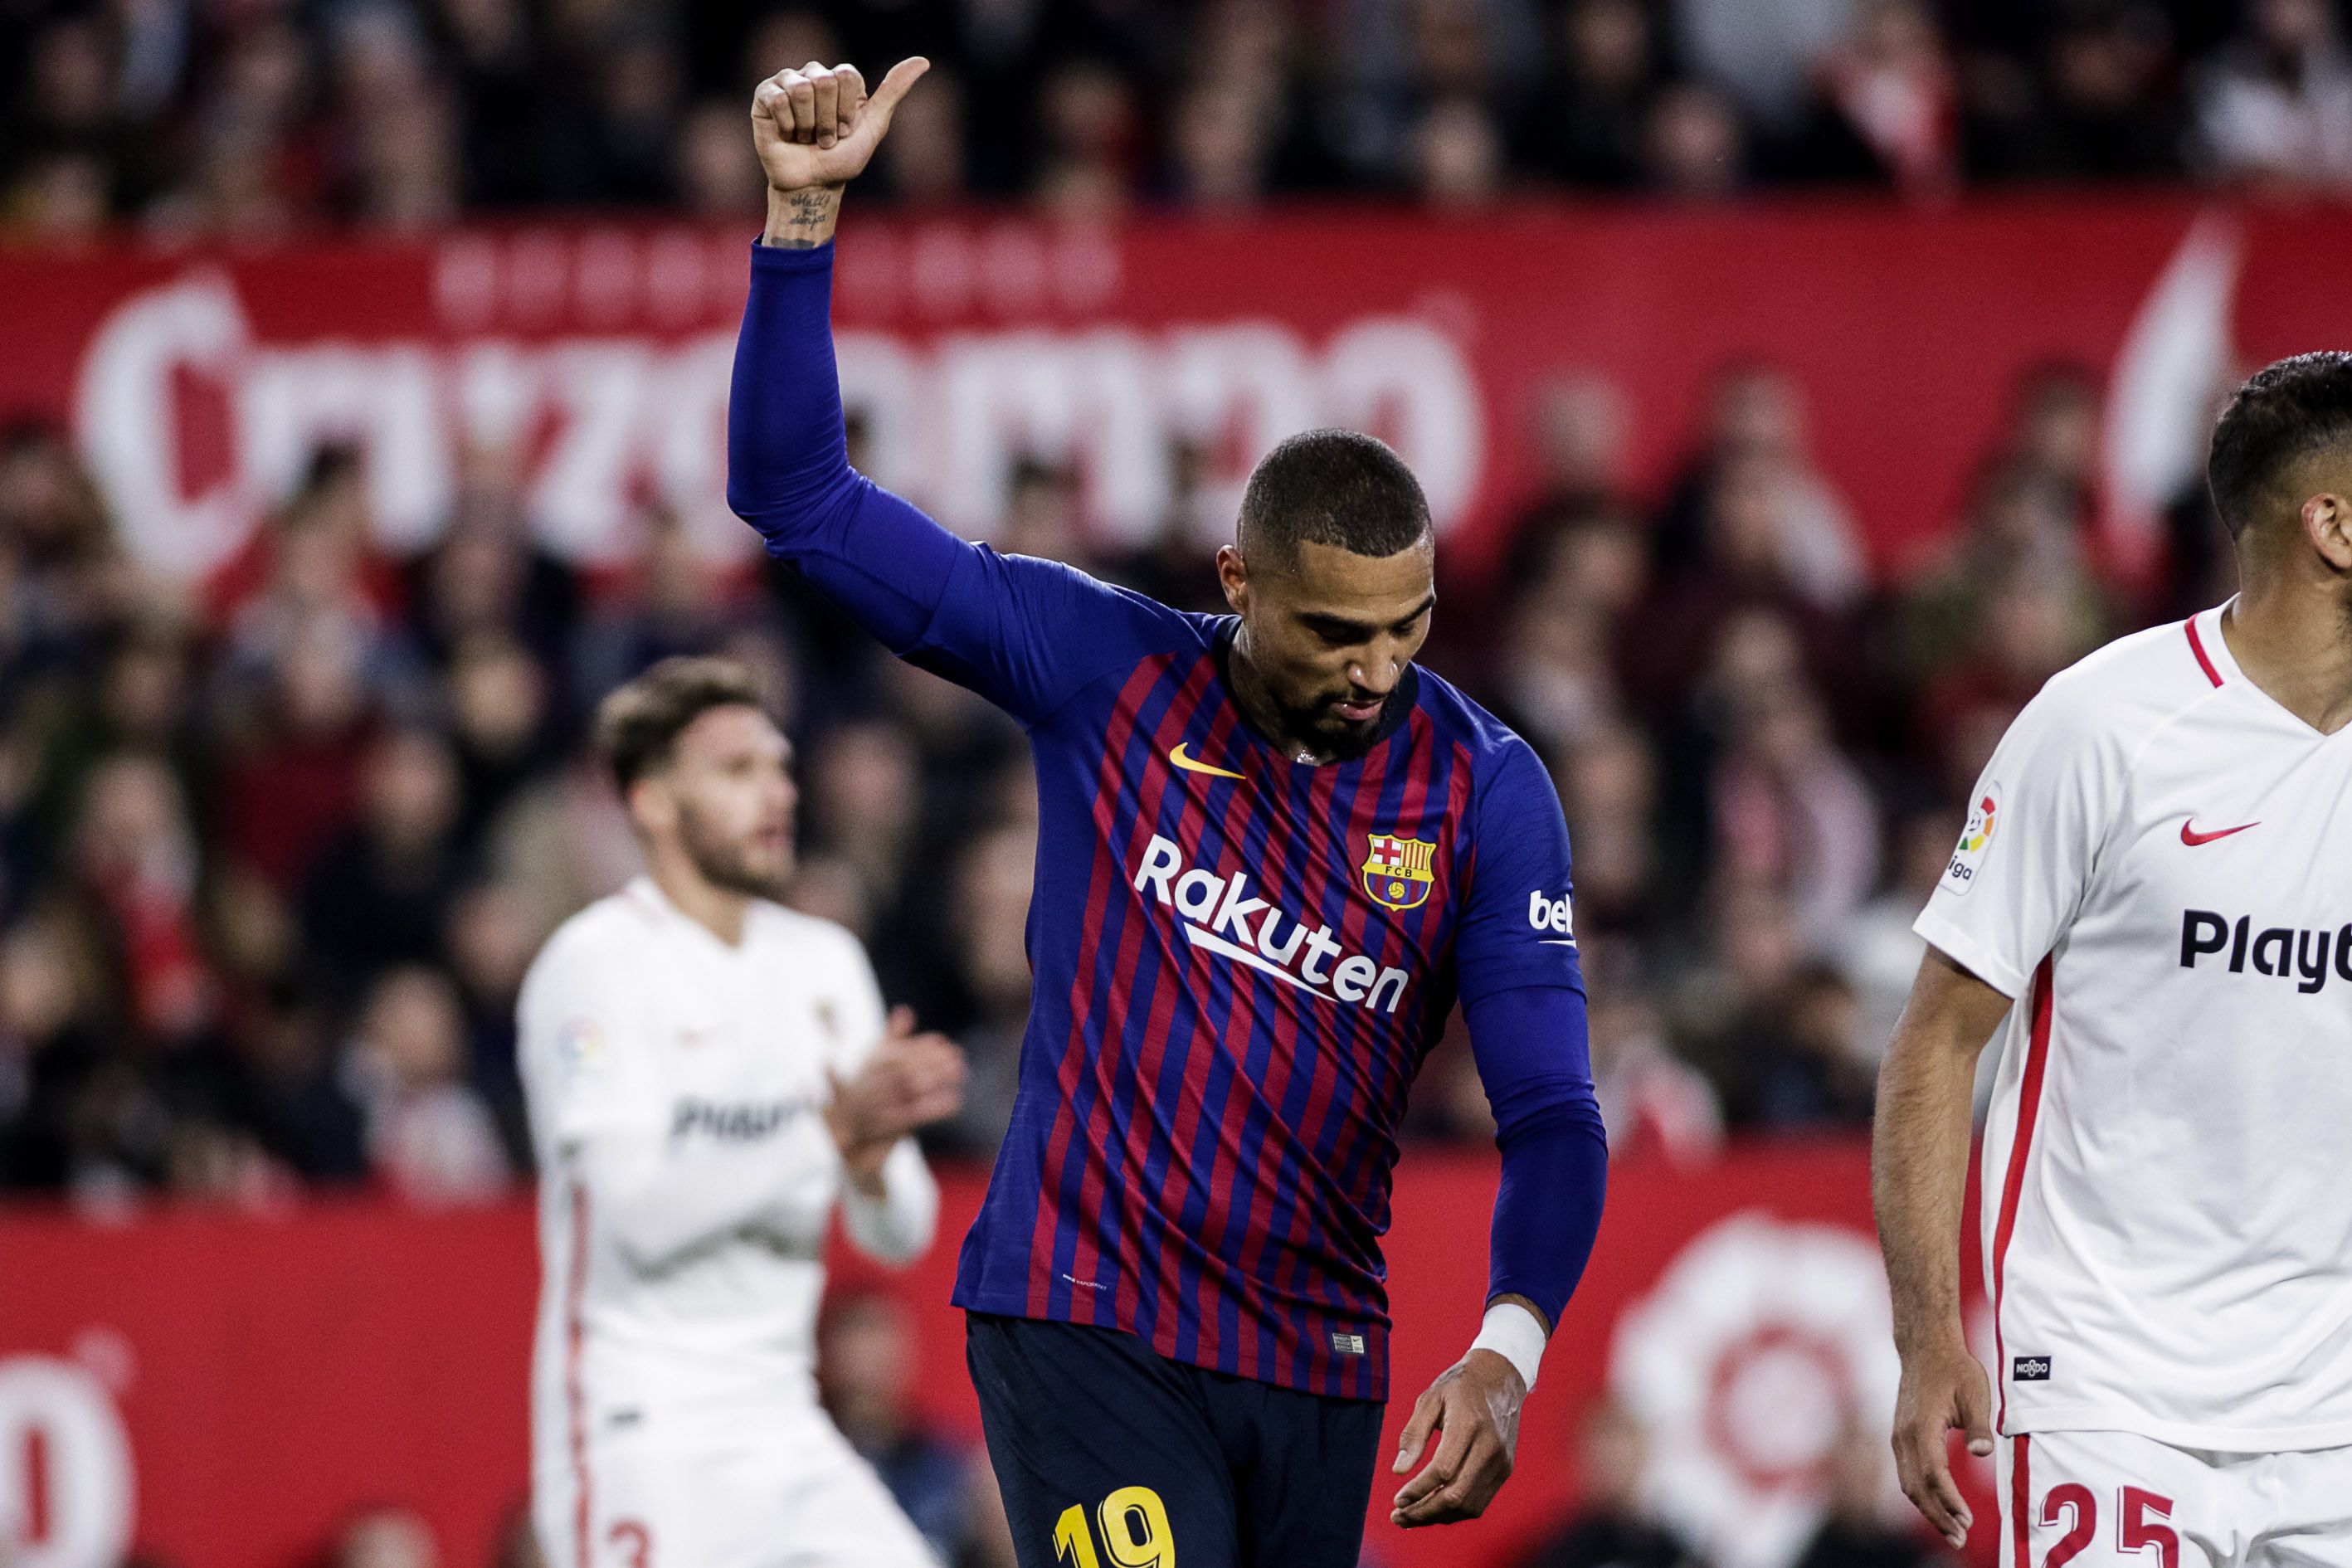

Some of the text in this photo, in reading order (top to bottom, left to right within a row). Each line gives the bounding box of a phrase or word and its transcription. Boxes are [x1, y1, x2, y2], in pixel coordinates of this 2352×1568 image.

[1133, 833, 1409, 1014] Rakuten
[1052, 1486, 1176, 1568] 19
[2038, 1483, 2179, 1568] 25
